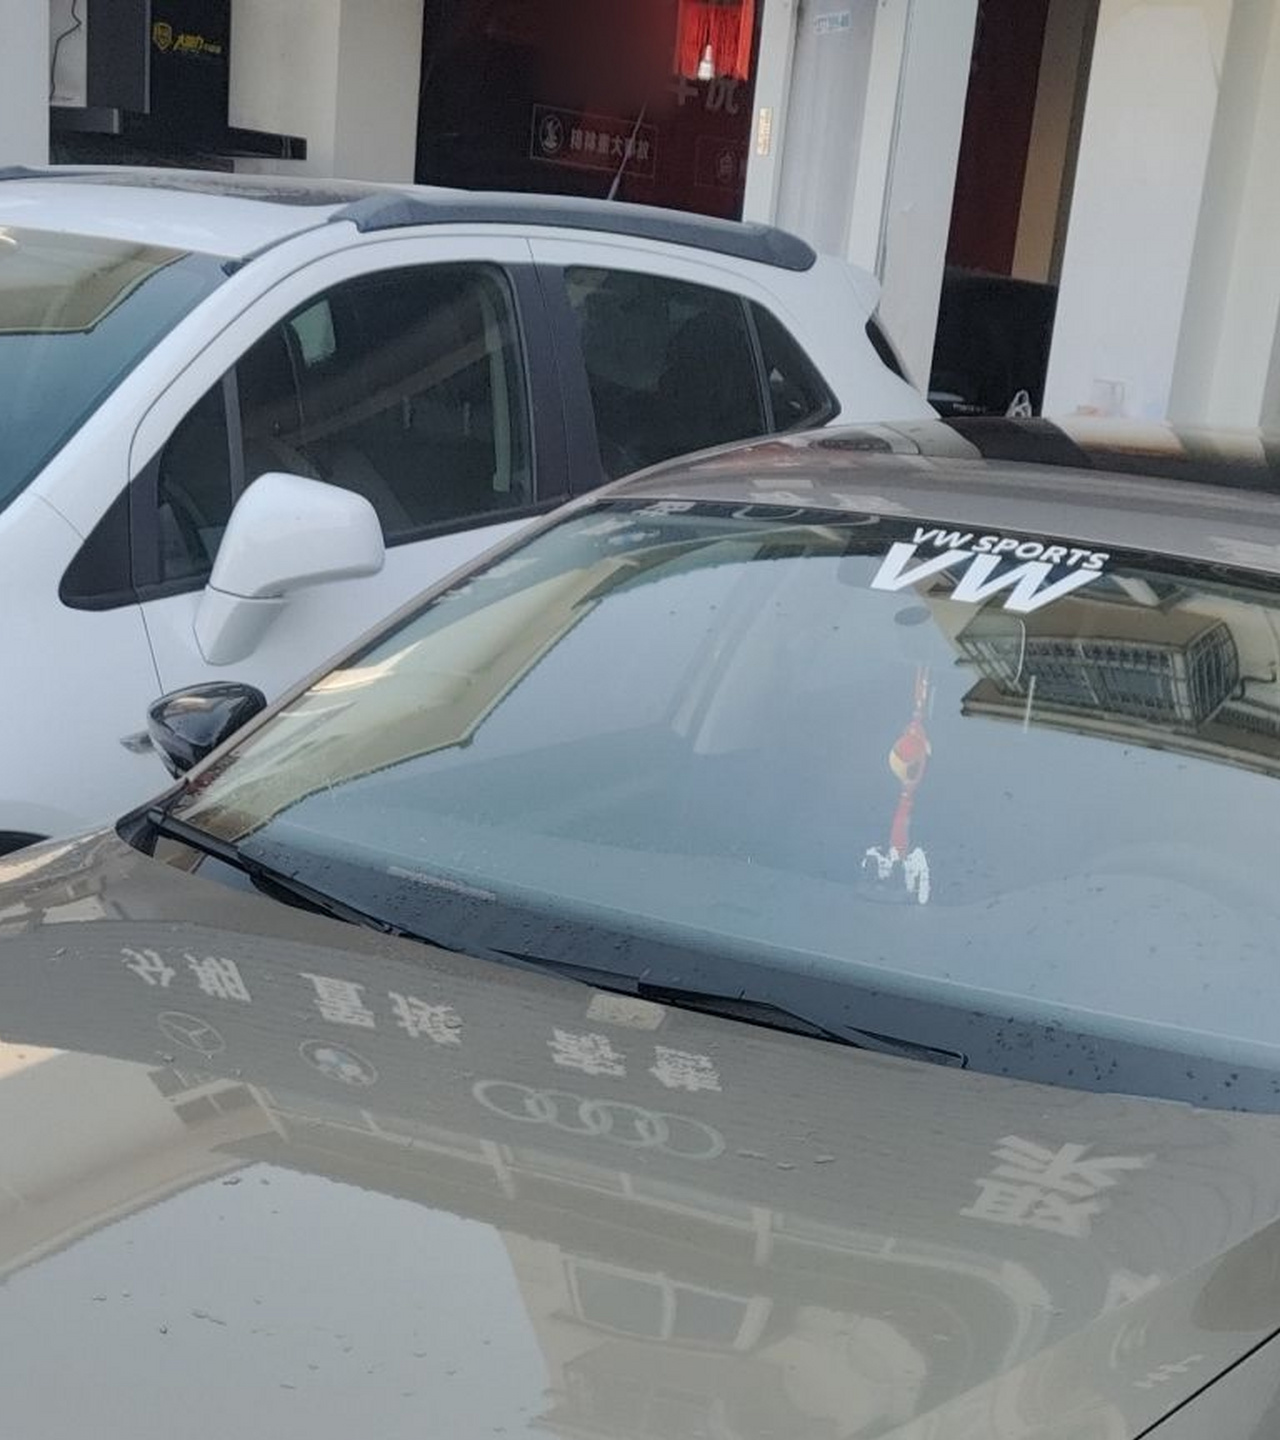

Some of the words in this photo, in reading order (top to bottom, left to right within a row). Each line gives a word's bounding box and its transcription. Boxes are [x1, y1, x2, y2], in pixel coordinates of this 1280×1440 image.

[870, 541, 1104, 614] VW
[913, 527, 974, 549] VW
[971, 535, 1111, 571] SPORTS
